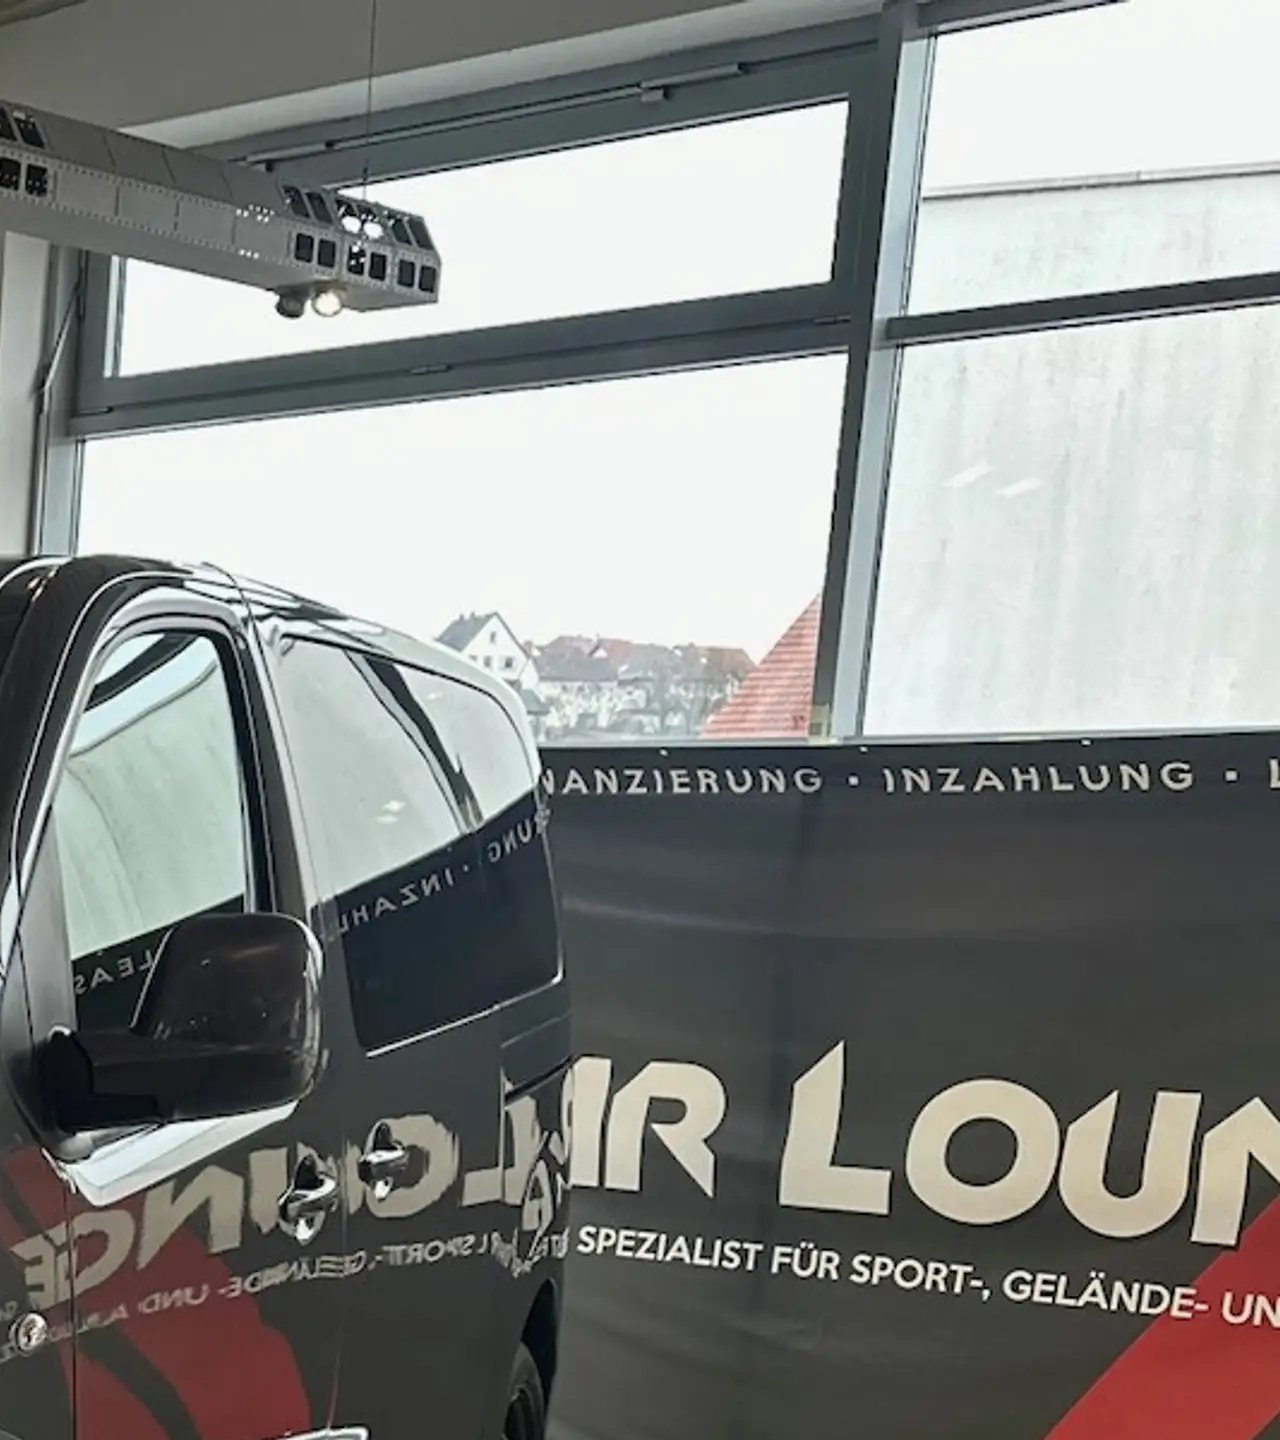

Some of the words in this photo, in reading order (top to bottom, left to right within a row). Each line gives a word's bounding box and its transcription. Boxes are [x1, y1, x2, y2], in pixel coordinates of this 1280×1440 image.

[886, 762, 1195, 793] INZAHLUNG
[576, 1226, 763, 1273] SPEZIALIST
[771, 1242, 840, 1281] FÜR
[849, 1256, 992, 1302] SPORT-,
[1002, 1271, 1210, 1320] GELÄNDE-
